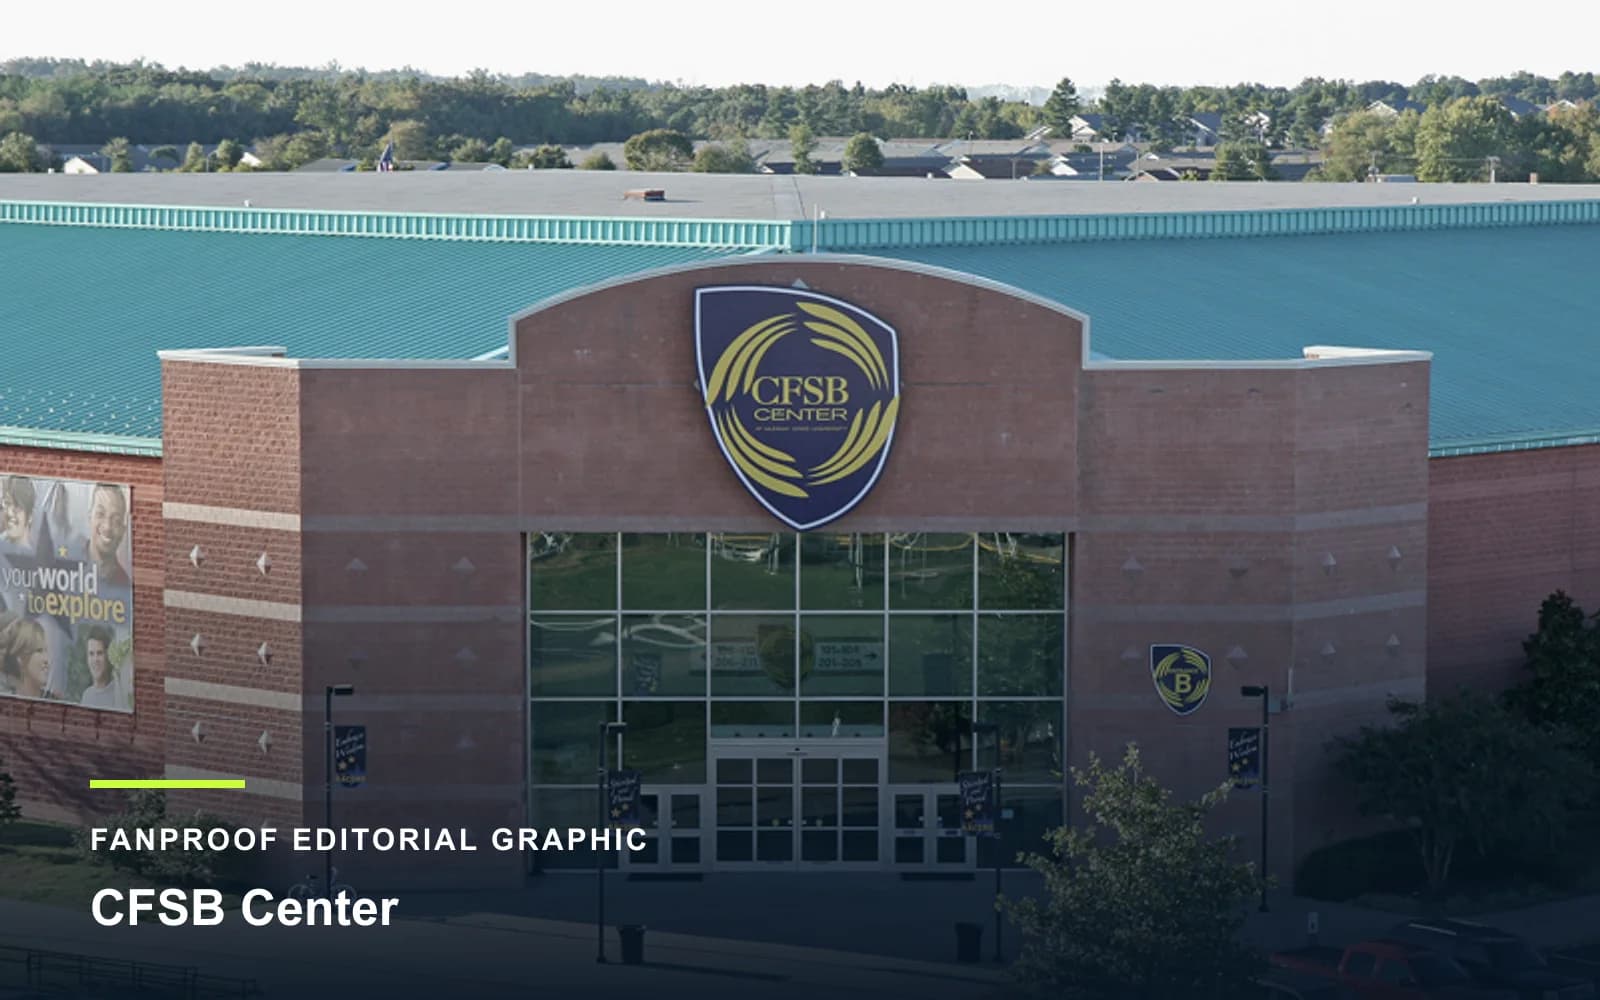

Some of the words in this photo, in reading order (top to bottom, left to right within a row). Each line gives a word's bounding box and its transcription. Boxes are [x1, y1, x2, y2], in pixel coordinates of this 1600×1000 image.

[751, 375, 849, 405] CFSB
[754, 408, 848, 421] CENTER
[1175, 673, 1192, 693] B
